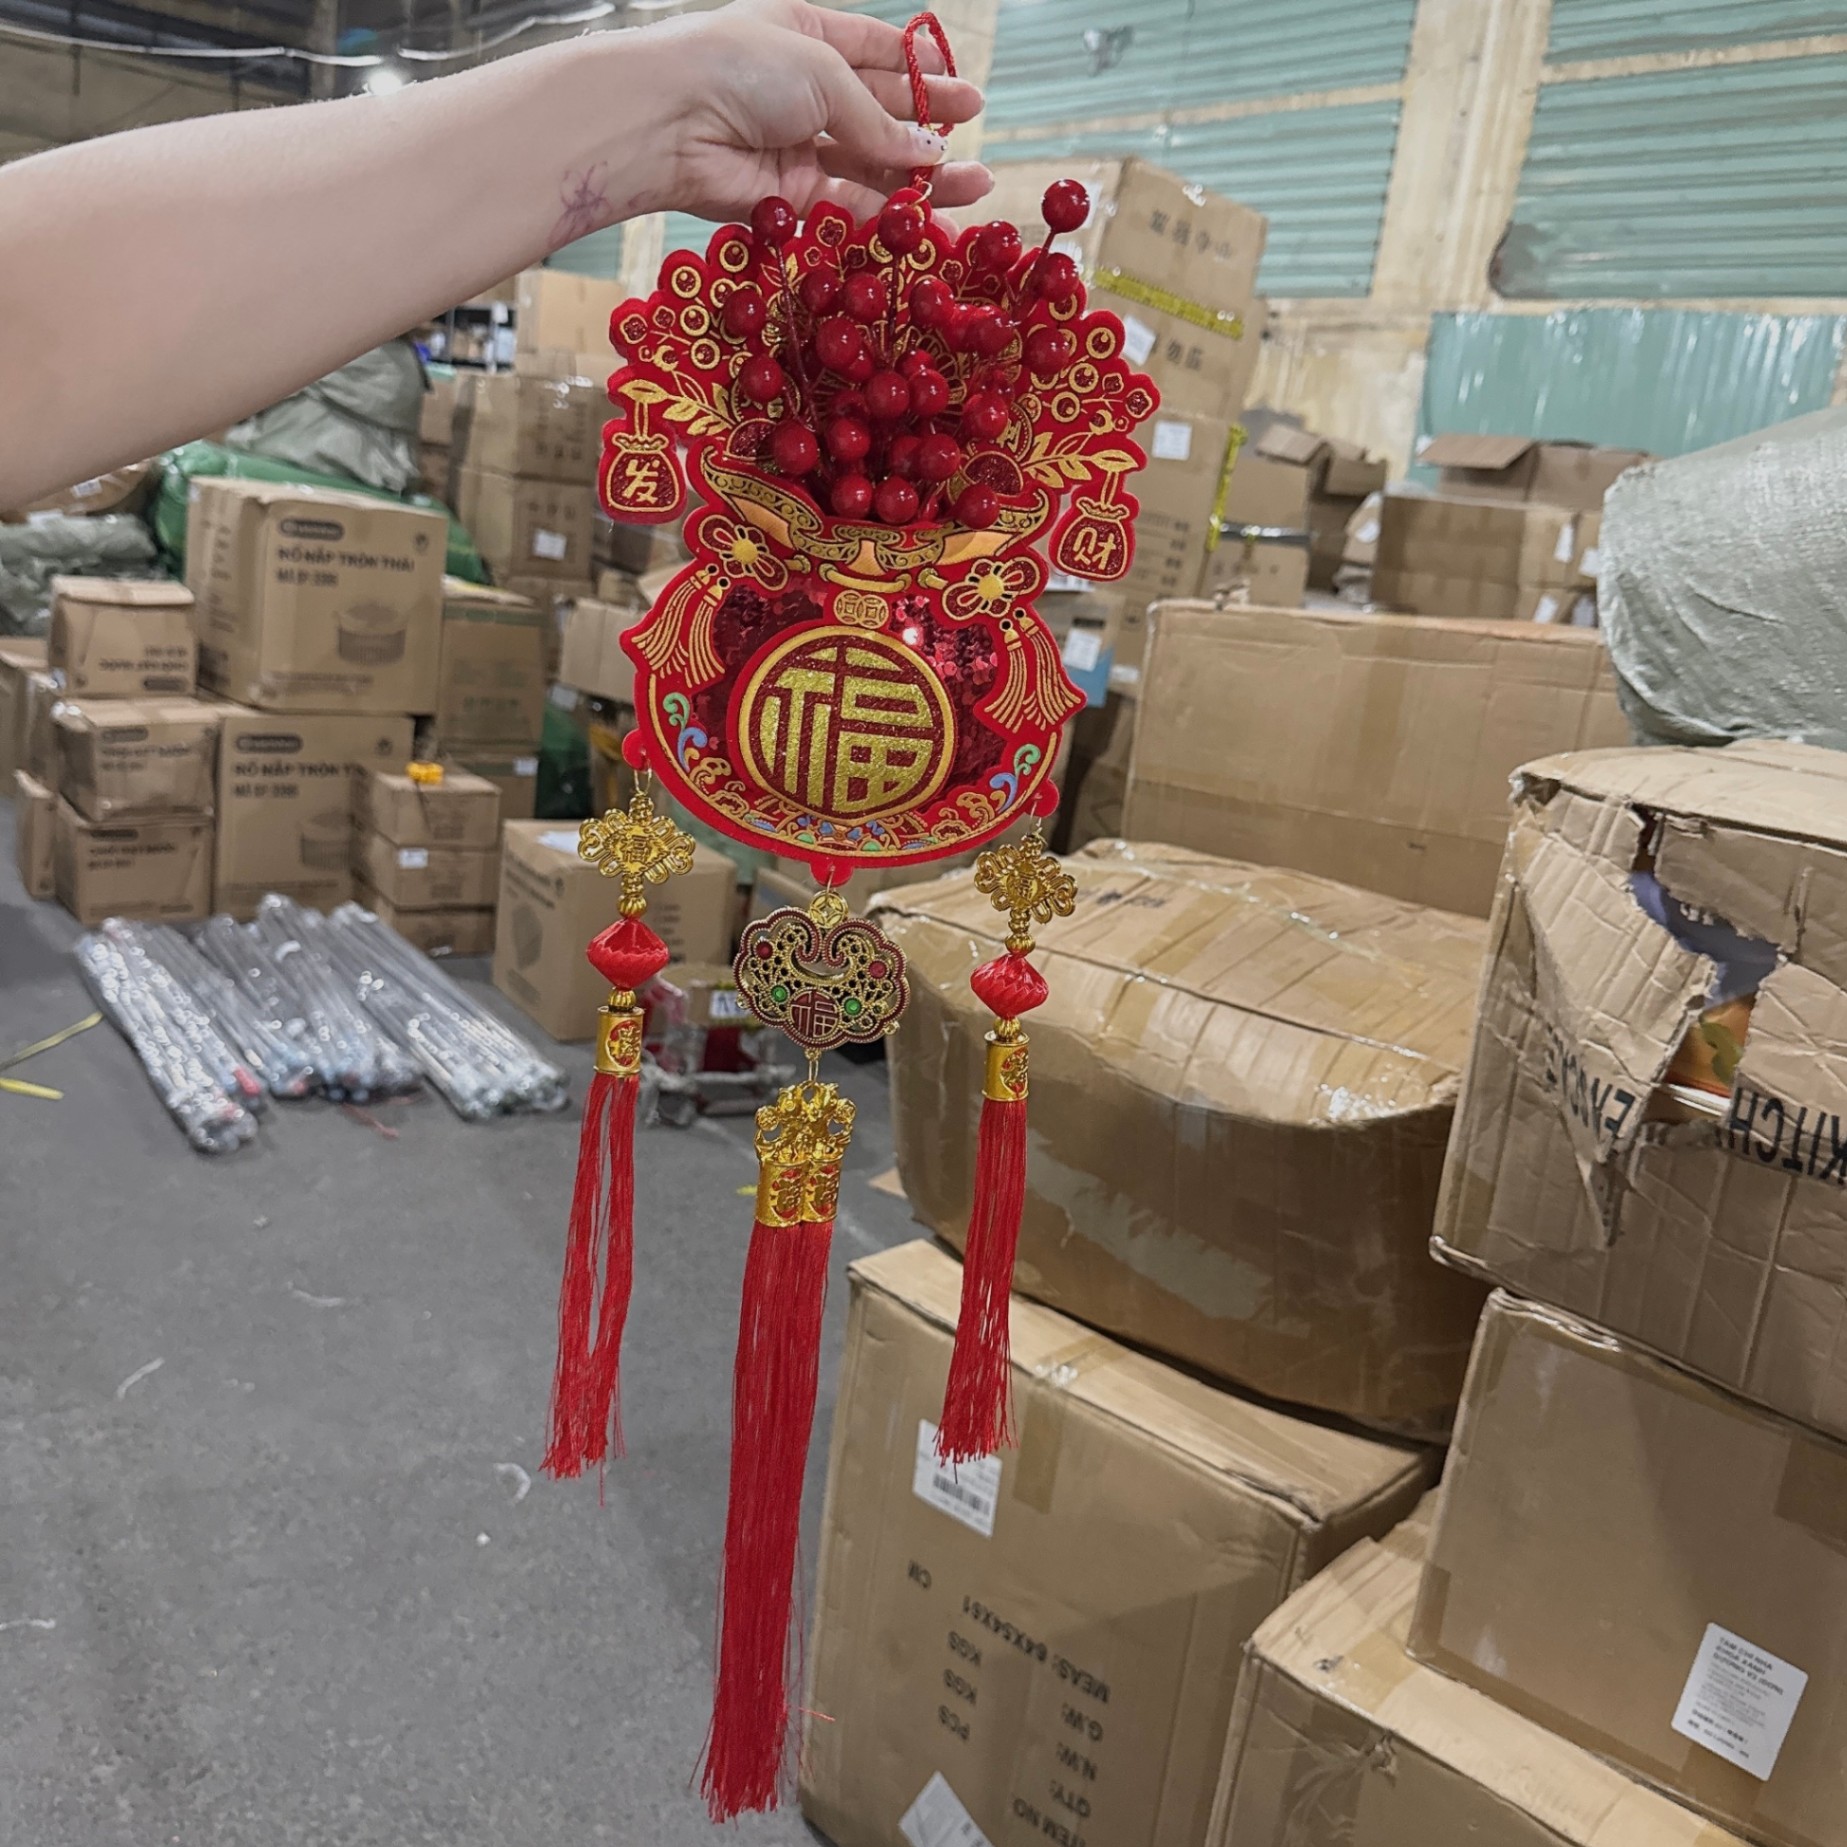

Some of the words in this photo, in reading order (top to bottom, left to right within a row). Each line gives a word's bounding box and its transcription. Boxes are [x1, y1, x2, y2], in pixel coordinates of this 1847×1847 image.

[621, 459, 661, 504] 发
[1072, 526, 1117, 570] 财
[760, 646, 935, 813] 福
[790, 990, 839, 1038] 福
[948, 1630, 982, 1668] KGS
[943, 1668, 977, 1706] KGS
[937, 1704, 971, 1741] PCS
